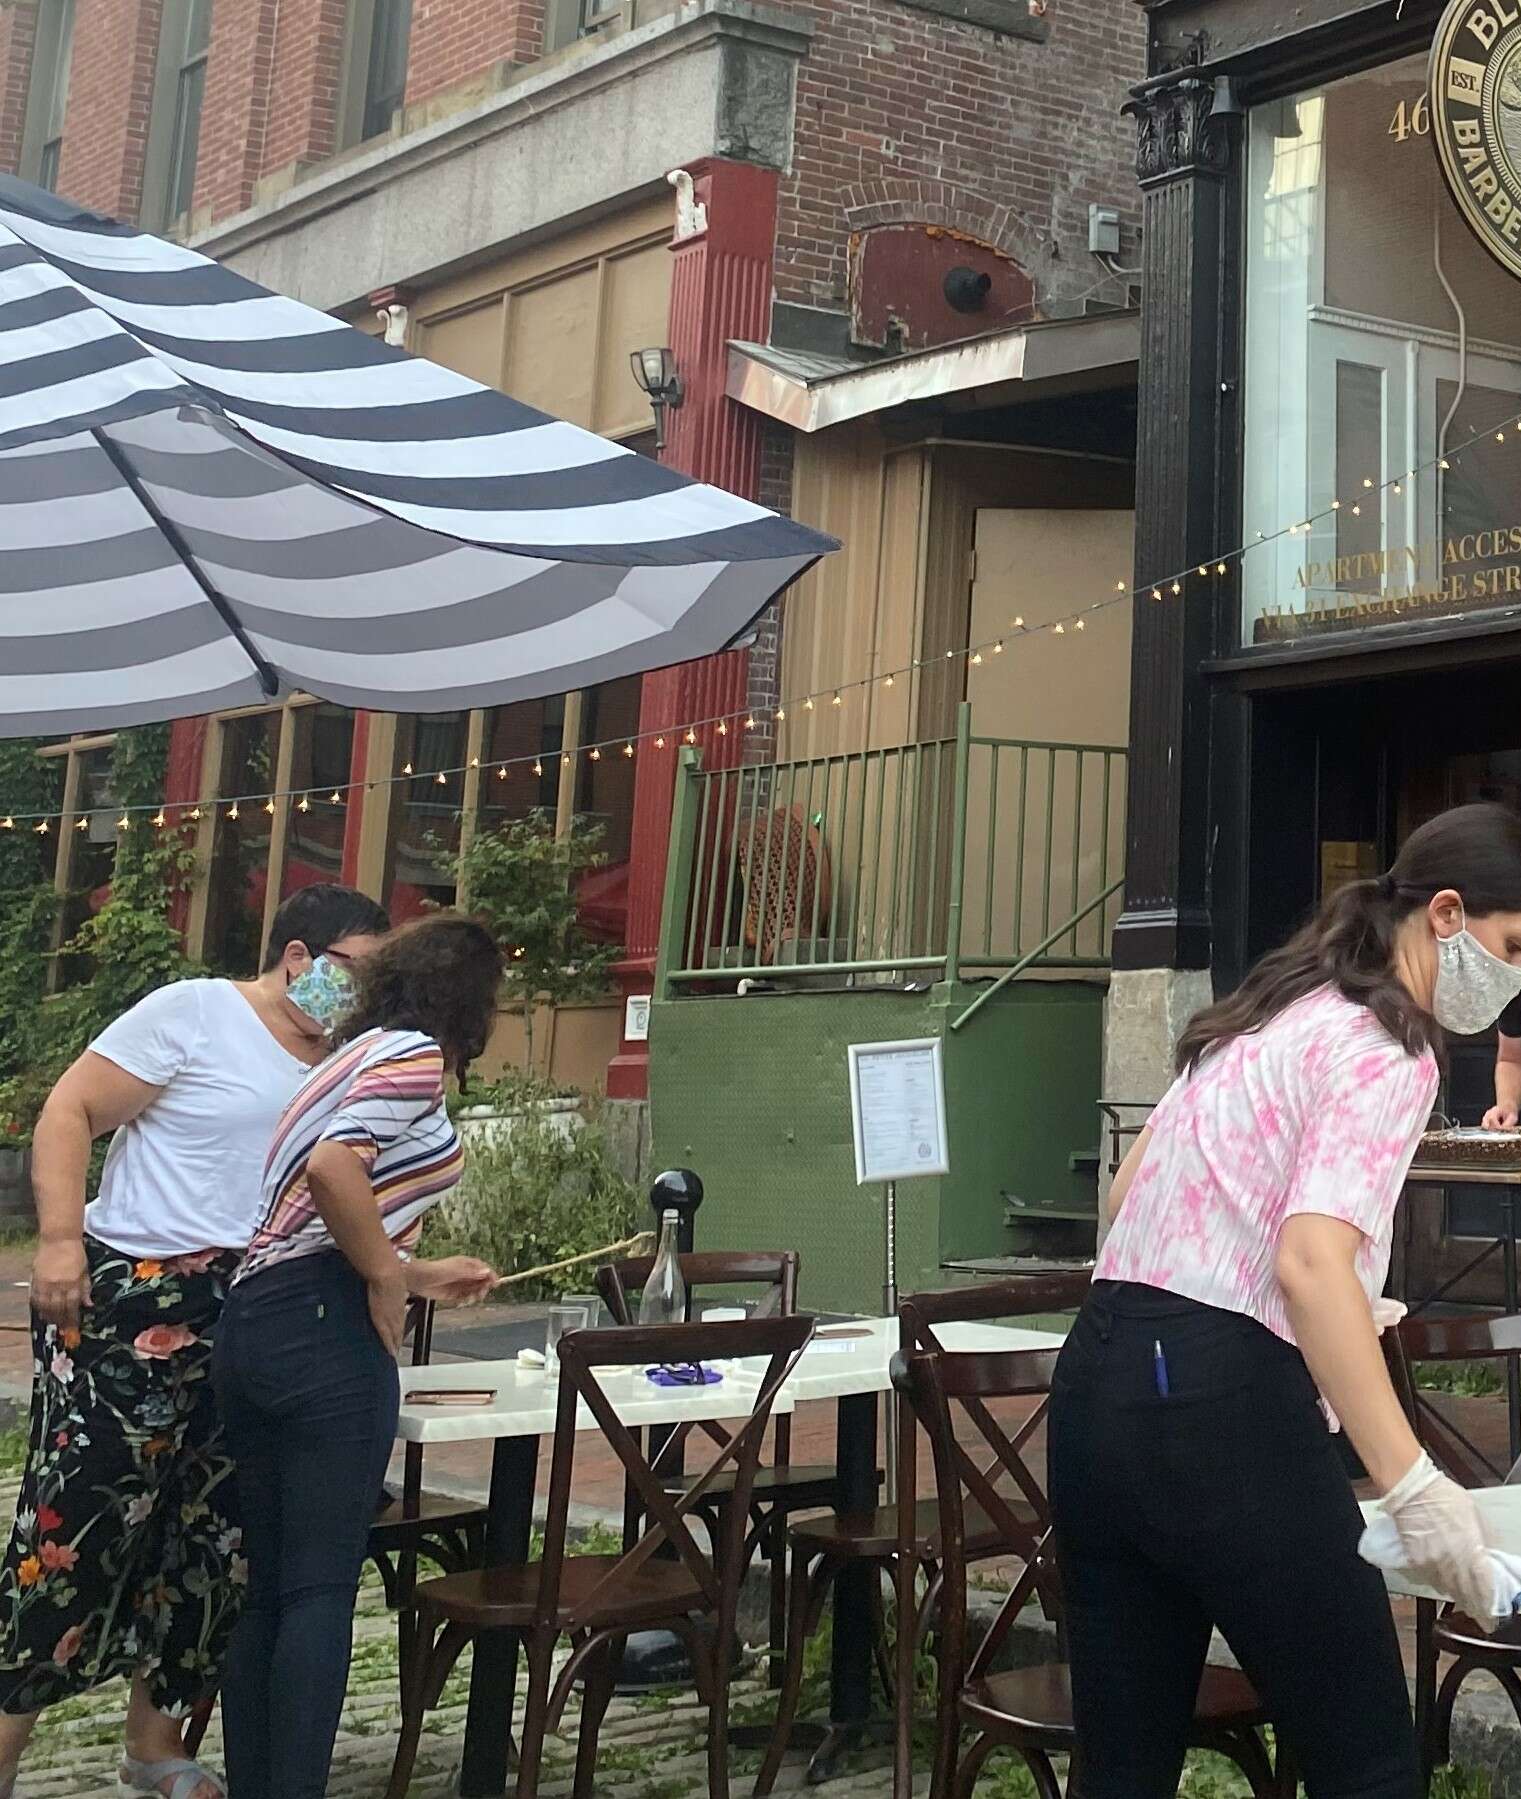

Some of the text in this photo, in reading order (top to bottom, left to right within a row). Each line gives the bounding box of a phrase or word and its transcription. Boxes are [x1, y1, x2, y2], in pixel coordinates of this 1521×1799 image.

[1451, 69, 1480, 93] EST.
[1388, 91, 1430, 143] 46
[1261, 603, 1300, 632] VIA
